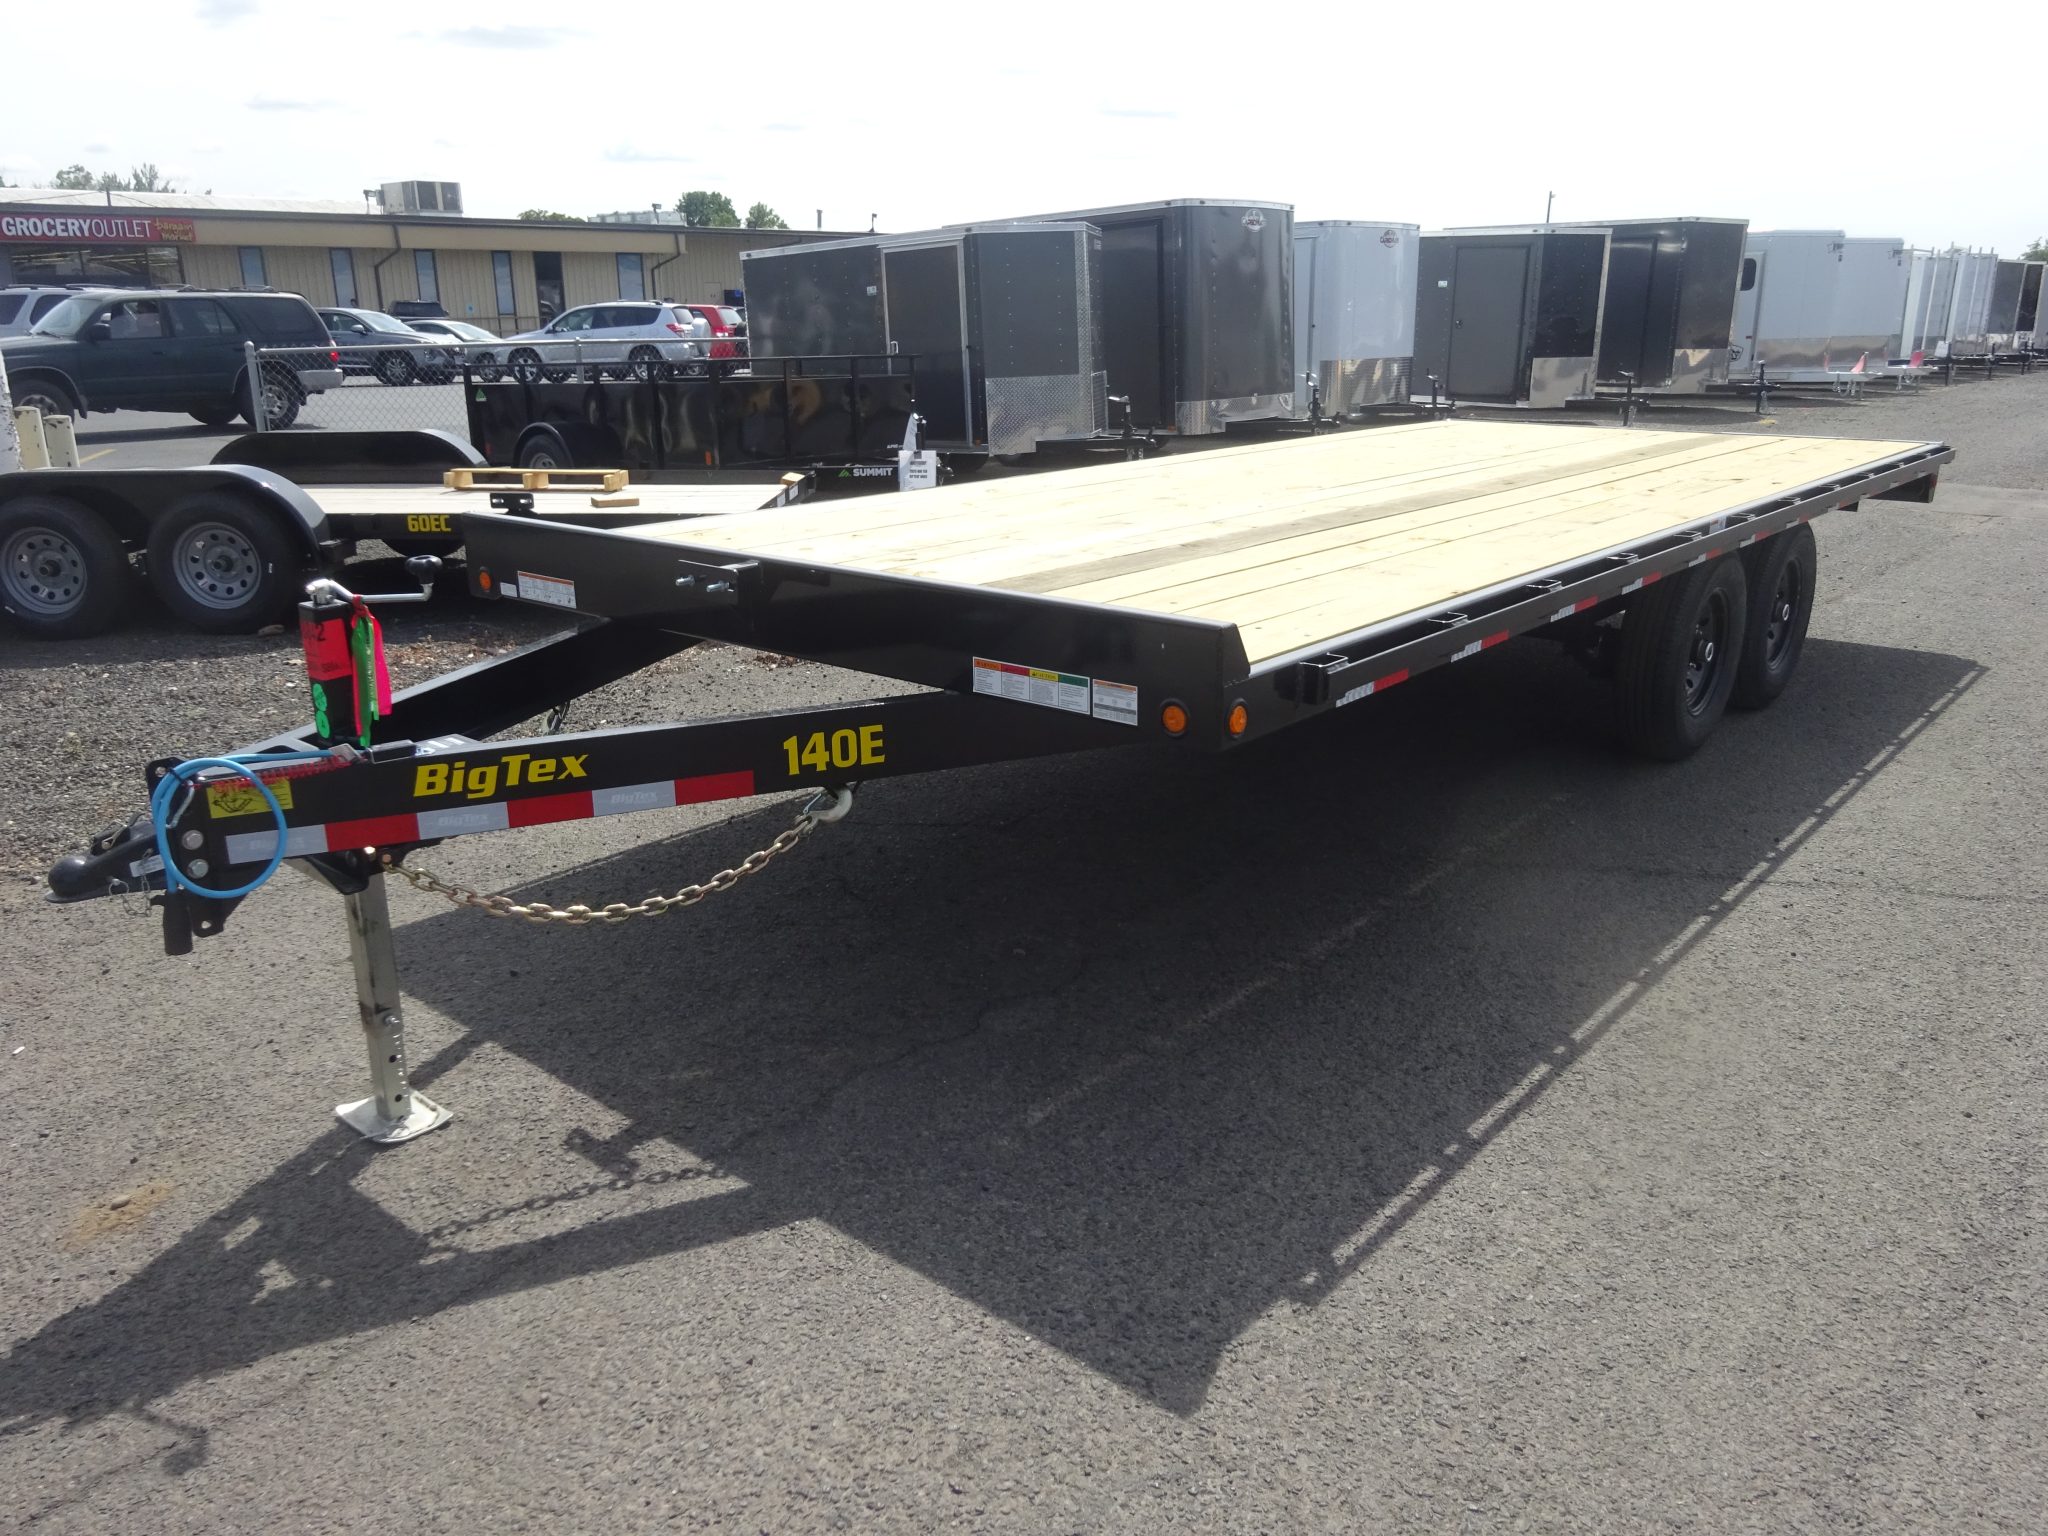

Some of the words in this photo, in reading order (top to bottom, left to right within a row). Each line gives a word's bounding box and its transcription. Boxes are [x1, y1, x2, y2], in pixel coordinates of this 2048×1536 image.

[852, 467, 893, 477] SUMMIT
[407, 514, 451, 532] 60EC
[783, 724, 885, 776] 140E
[413, 754, 589, 800] BigTex
